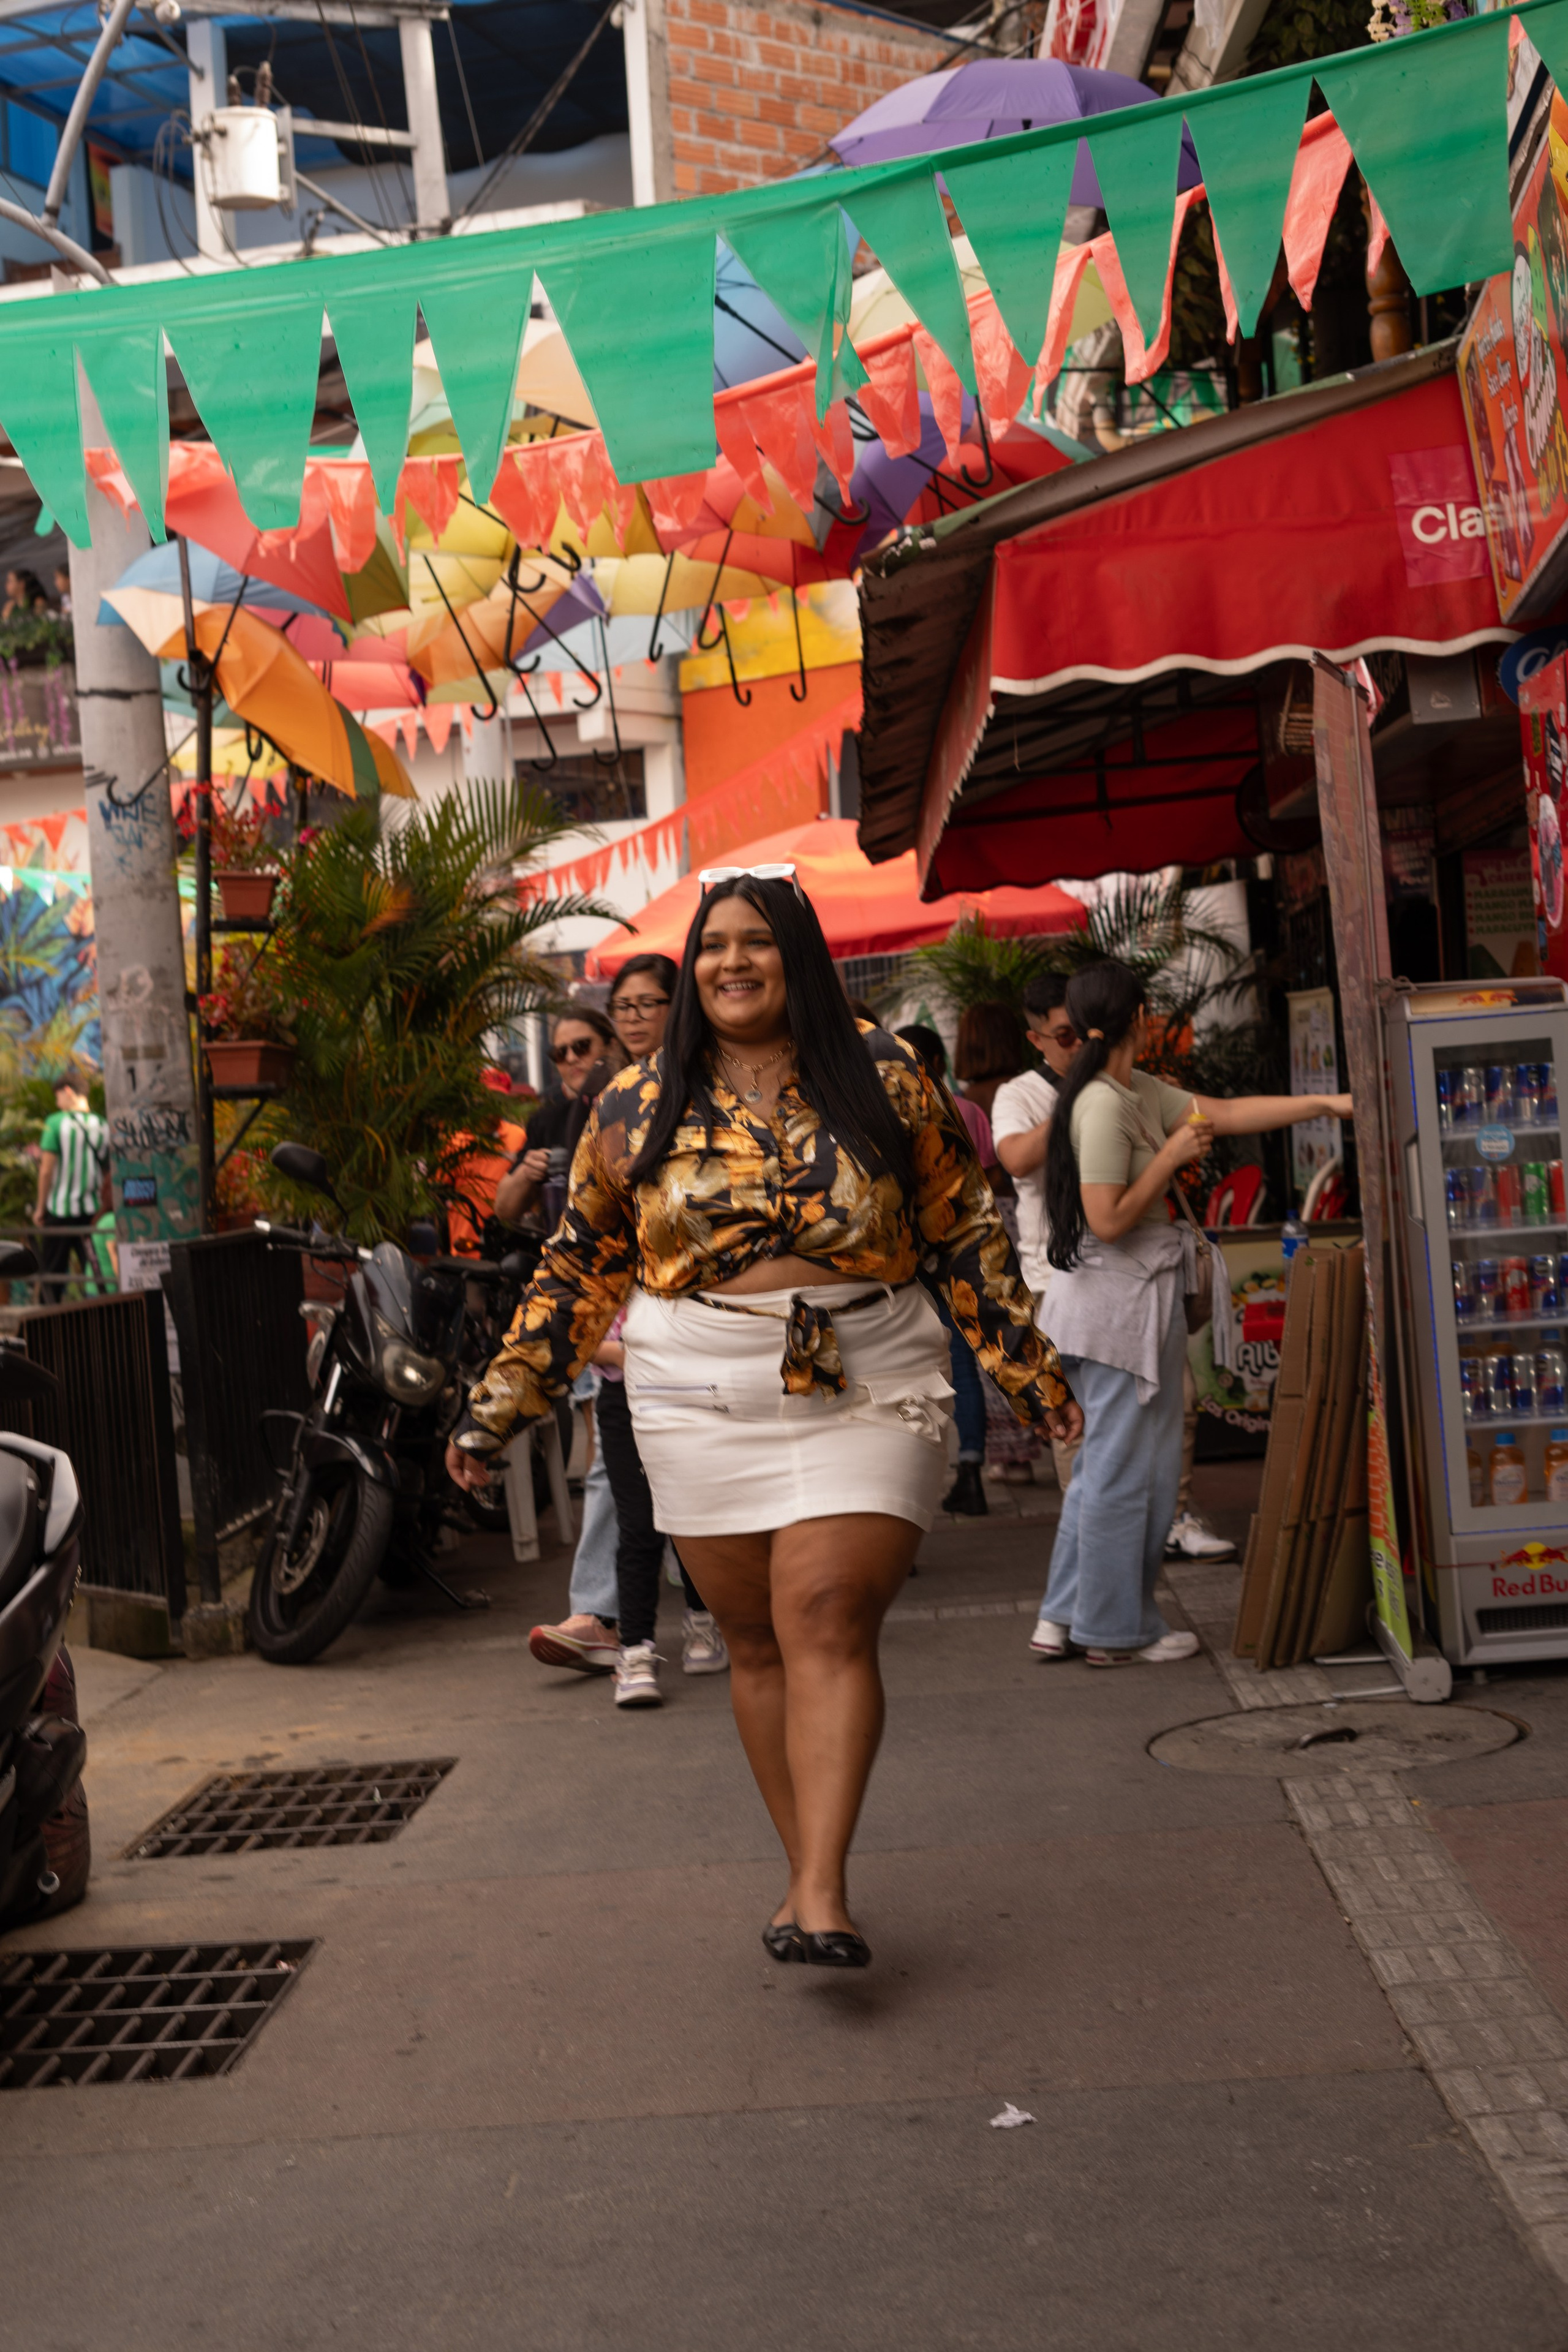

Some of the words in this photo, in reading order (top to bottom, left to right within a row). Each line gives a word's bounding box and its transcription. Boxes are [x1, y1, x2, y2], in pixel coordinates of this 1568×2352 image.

[1200, 1393, 1224, 1419] Las
[1493, 1575, 1536, 1597] Red
[1540, 1574, 1568, 1593] Bu
